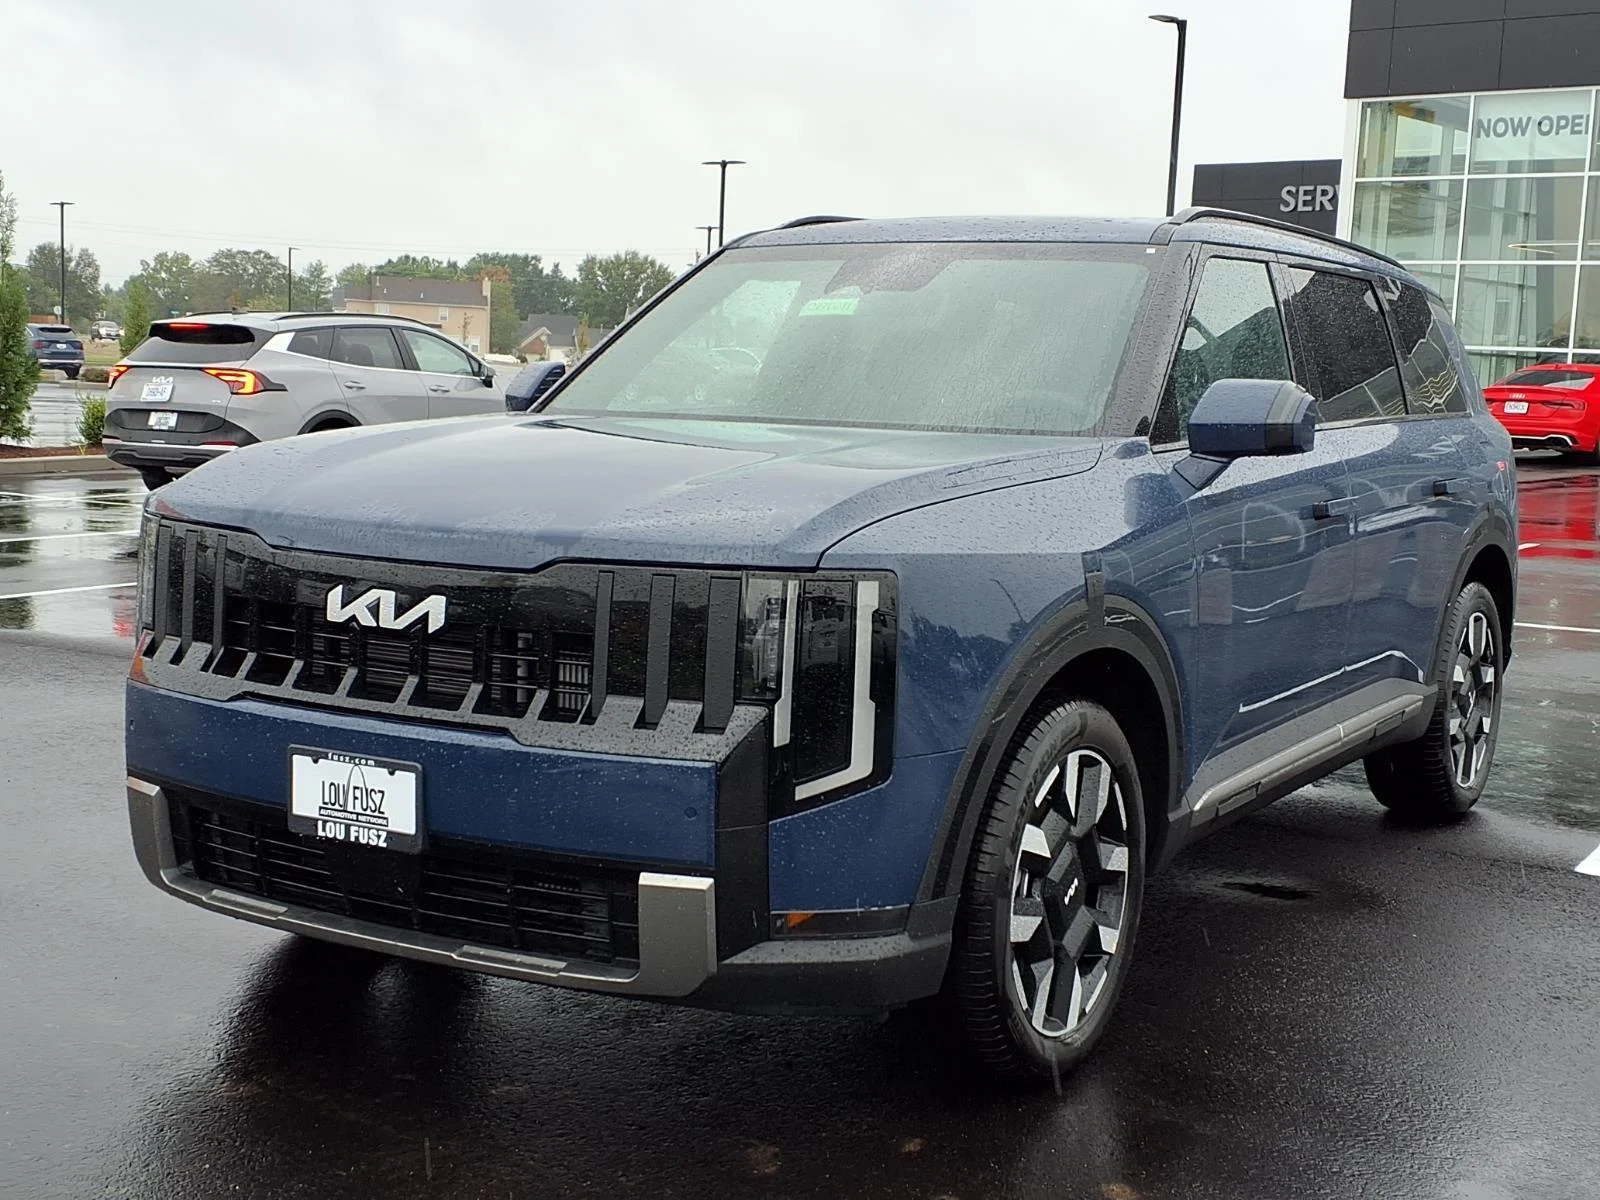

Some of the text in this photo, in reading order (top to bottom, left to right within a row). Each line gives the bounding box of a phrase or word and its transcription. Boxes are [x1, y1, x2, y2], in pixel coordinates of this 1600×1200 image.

[1476, 116, 1532, 138] NOW
[327, 584, 446, 634] KIA
[328, 752, 375, 767] fusz.com
[322, 781, 385, 815] LOU FUSZ
[320, 808, 388, 826] AUTOMOTIVE NETWORK
[317, 820, 387, 848] LOU FUSZ
